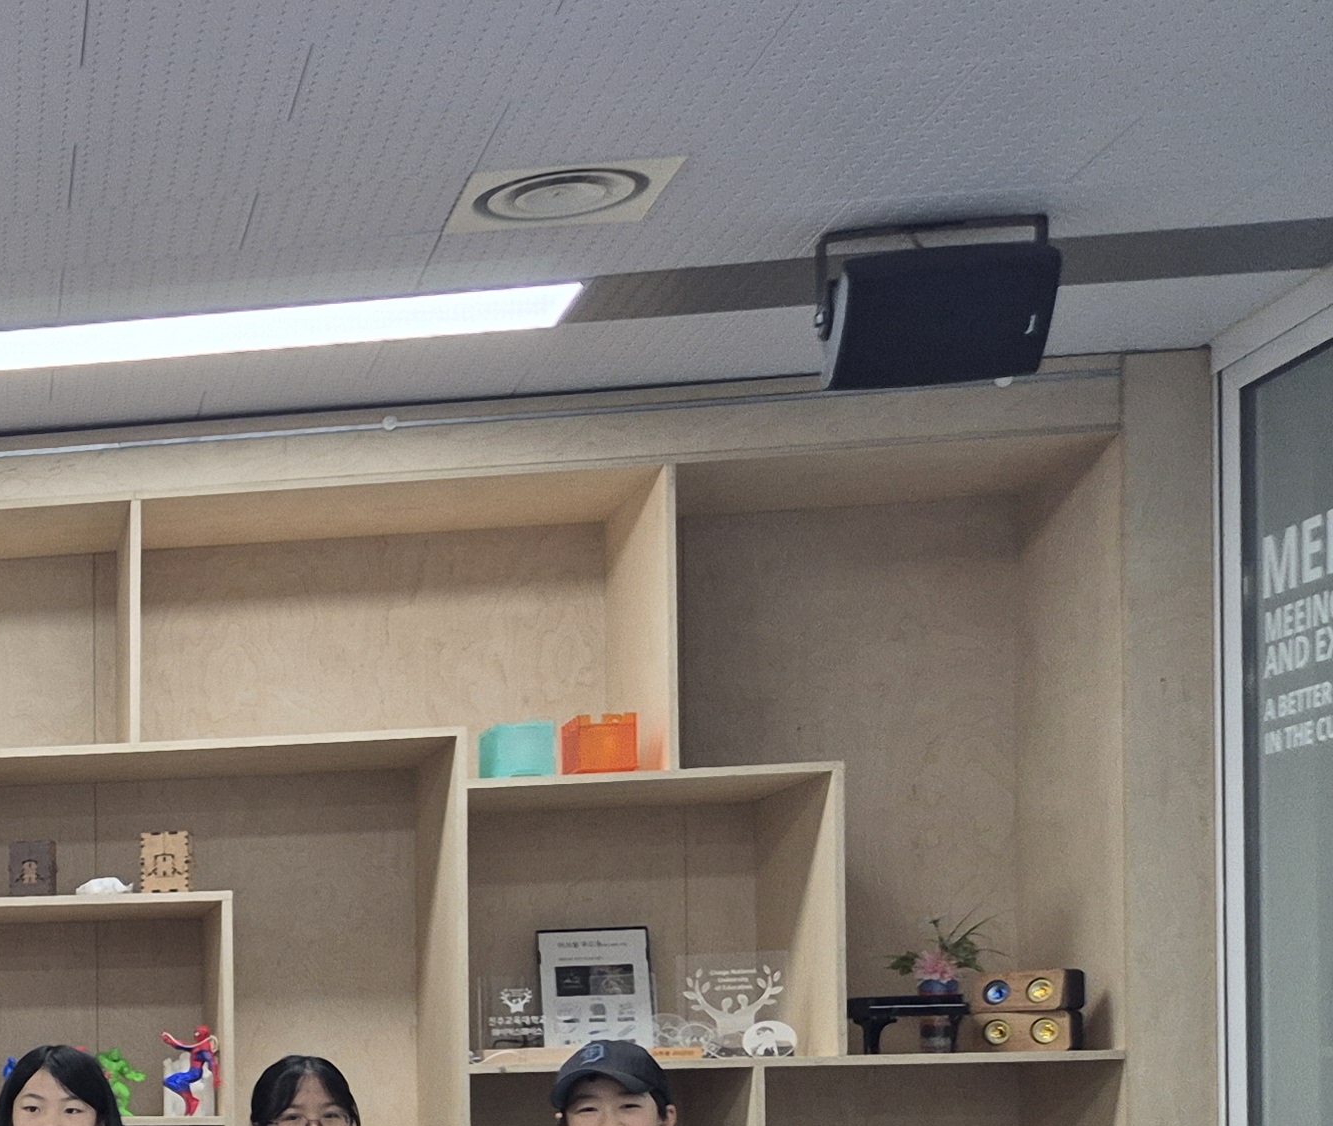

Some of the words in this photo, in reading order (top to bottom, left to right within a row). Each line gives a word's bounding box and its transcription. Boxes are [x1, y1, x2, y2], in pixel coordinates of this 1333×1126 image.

[1262, 509, 1333, 599] ME
[1263, 636, 1310, 679] AND
[1284, 720, 1314, 750] THE
